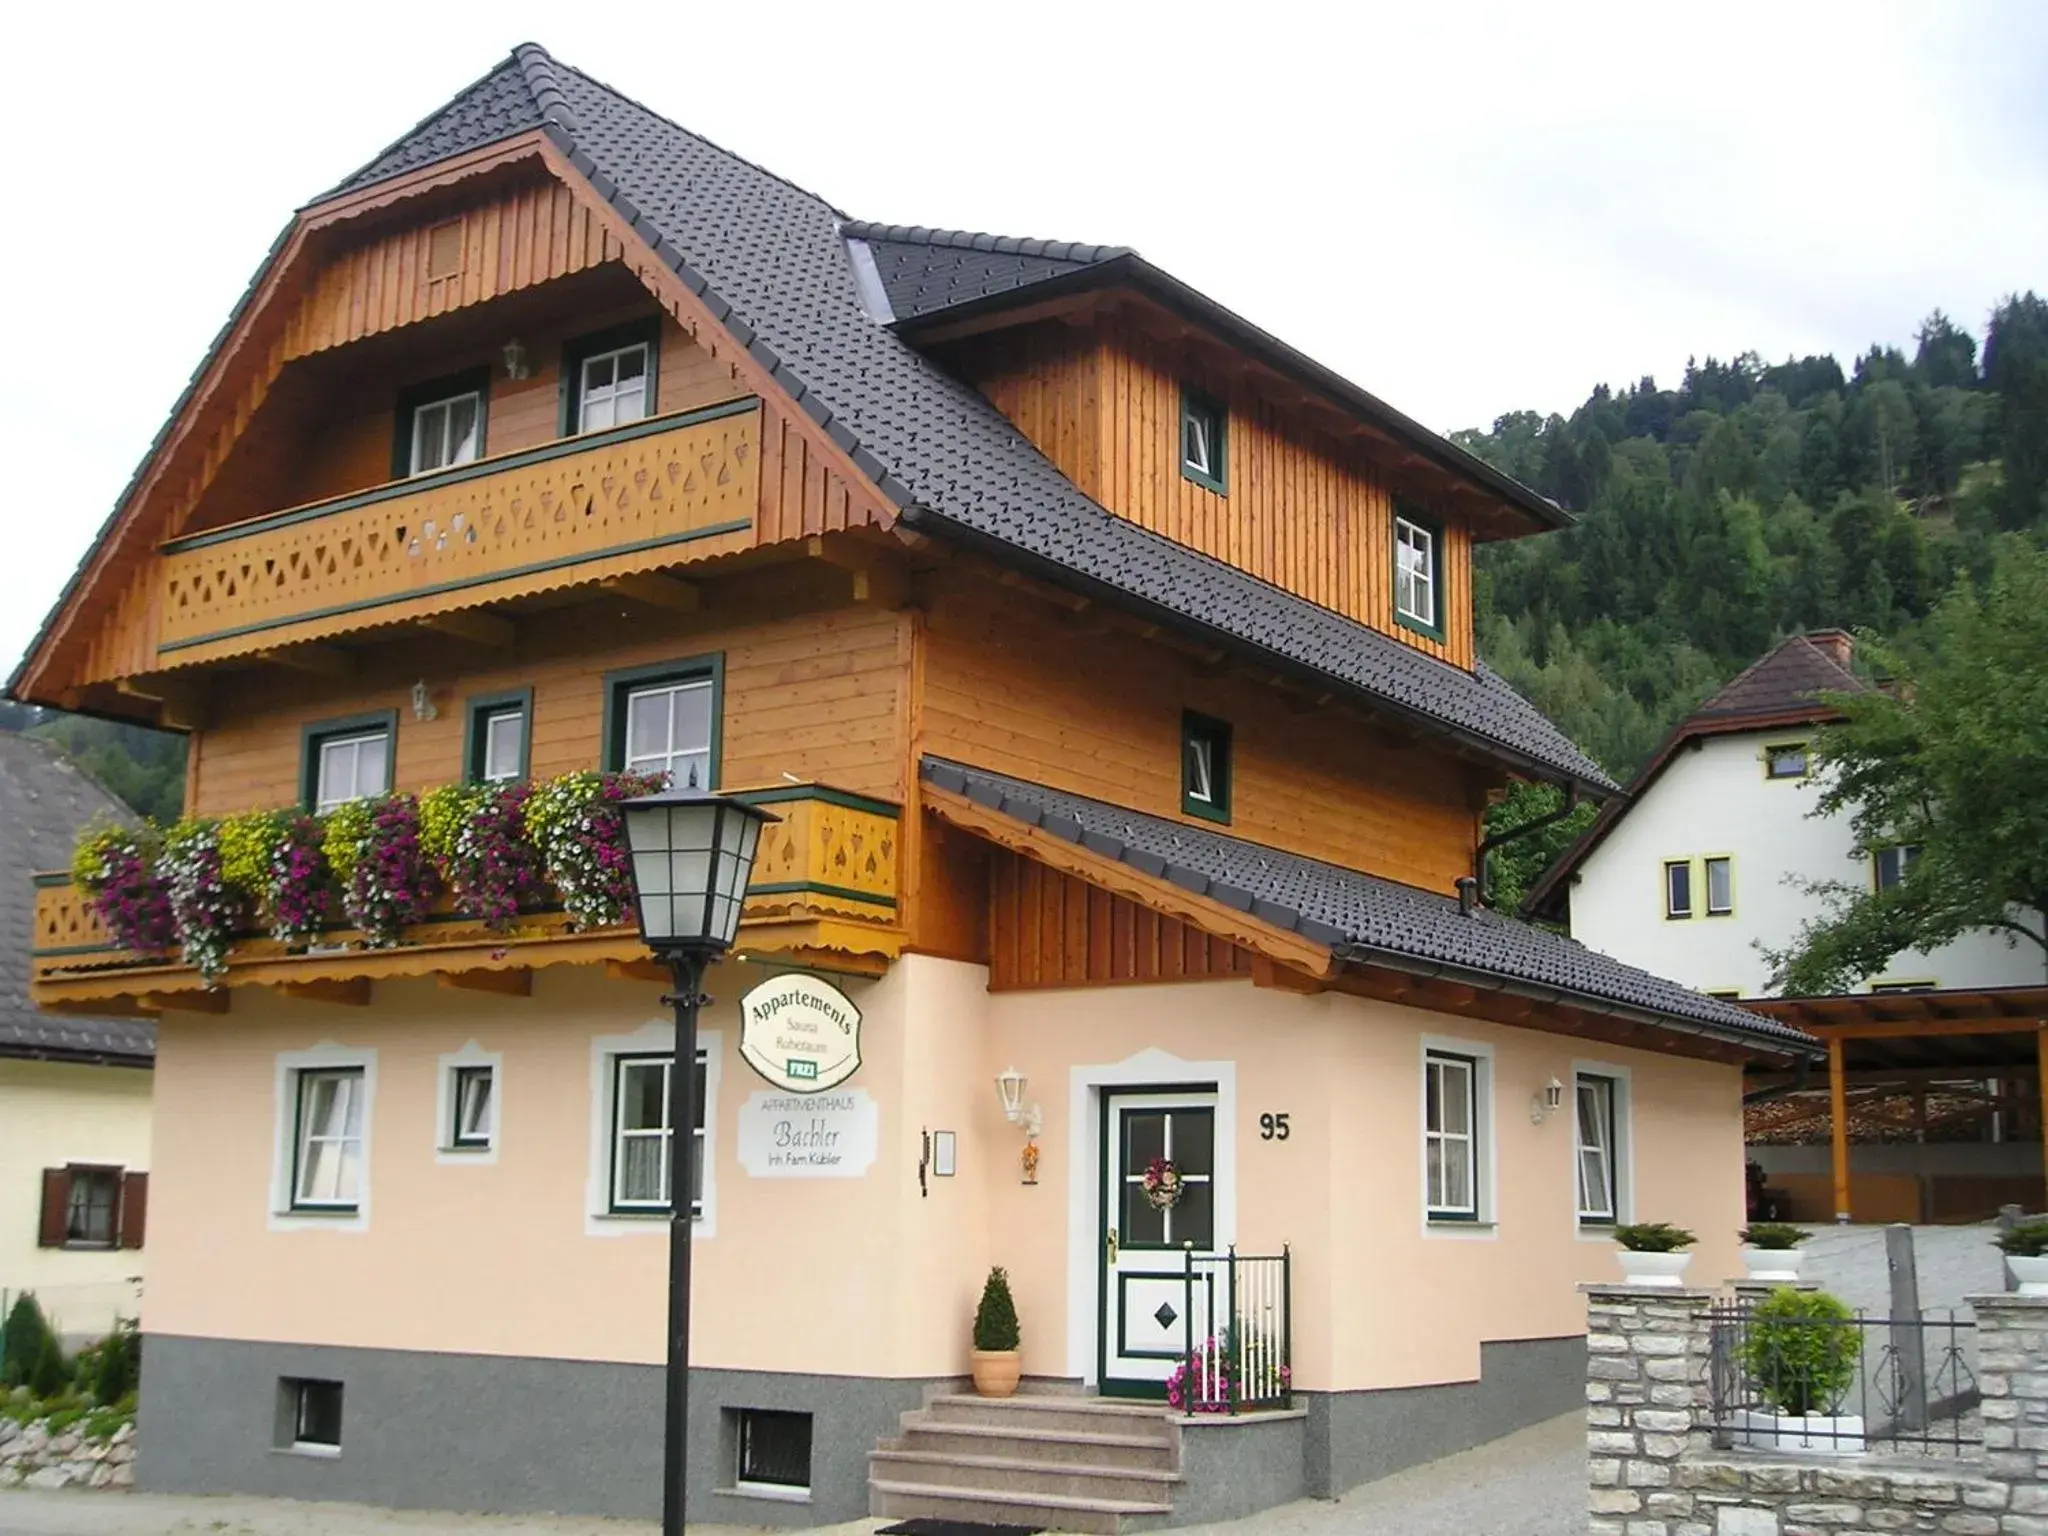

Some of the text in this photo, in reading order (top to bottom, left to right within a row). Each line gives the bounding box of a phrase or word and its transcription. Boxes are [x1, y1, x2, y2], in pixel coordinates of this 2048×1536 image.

[752, 989, 852, 1035] Appartements
[789, 1062, 815, 1077] FREI
[1260, 1113, 1290, 1141] 95
